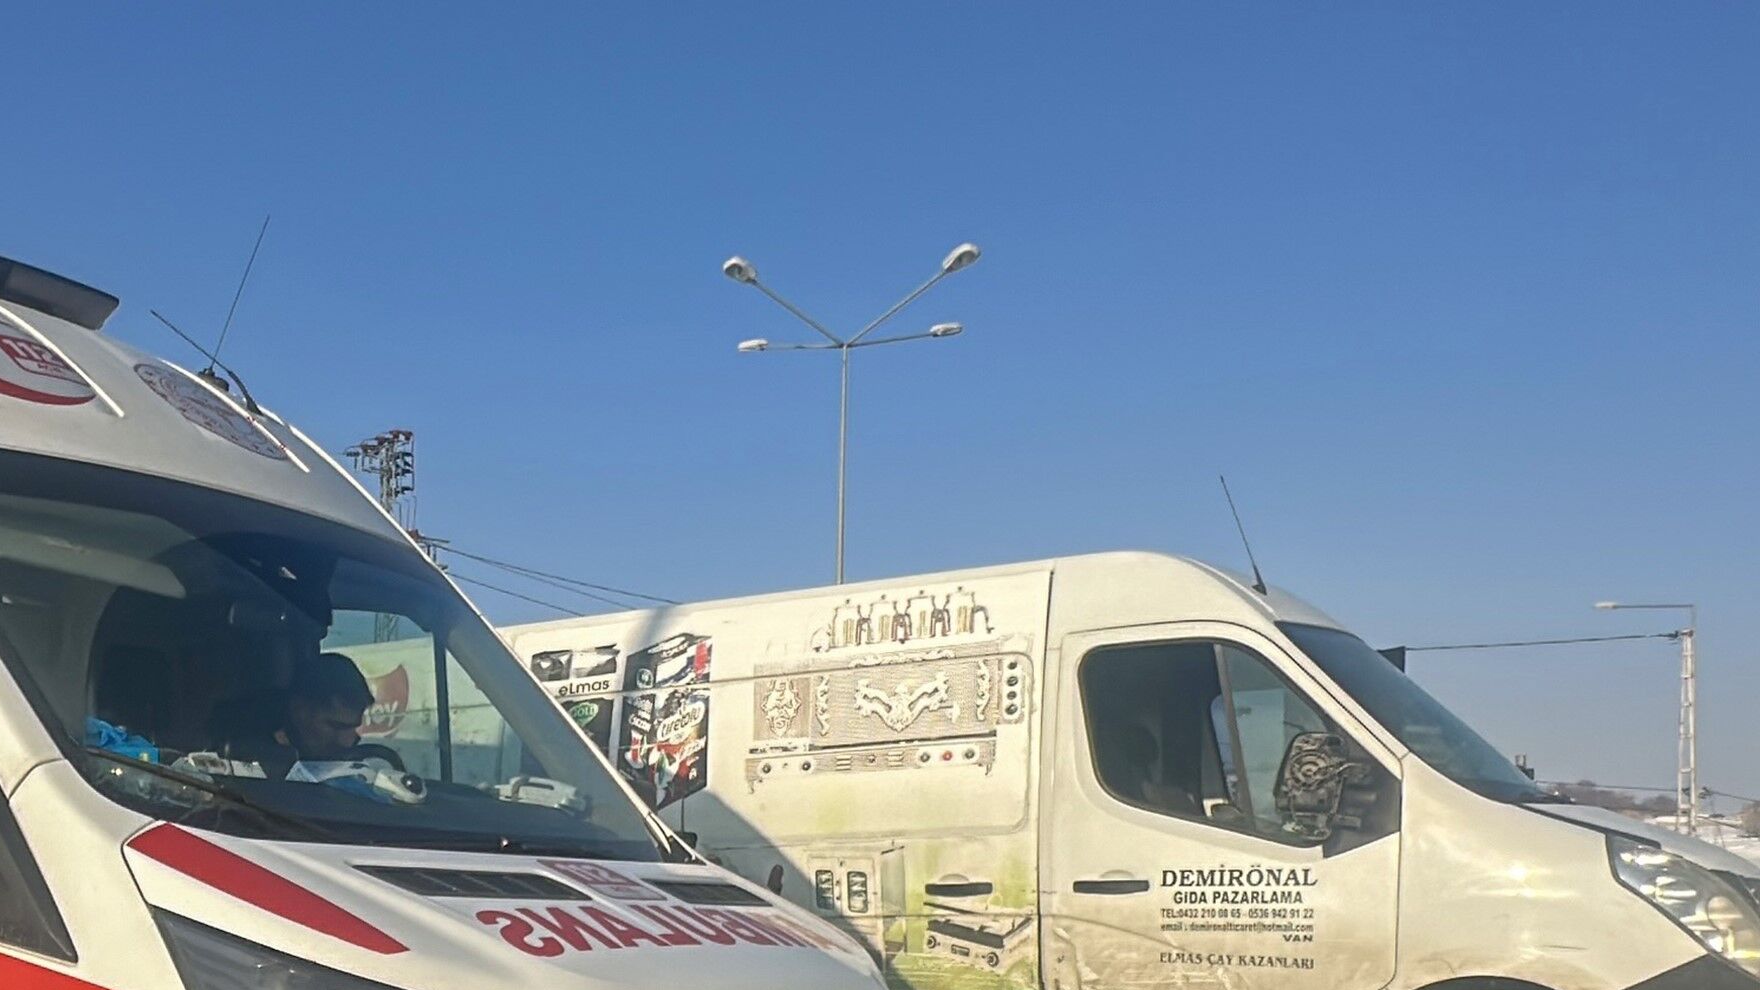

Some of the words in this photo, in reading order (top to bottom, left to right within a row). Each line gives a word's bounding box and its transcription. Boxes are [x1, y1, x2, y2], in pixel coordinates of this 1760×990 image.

[1161, 864, 1318, 887] DEMİRÖNAL
[1173, 891, 1208, 905] GIDA
[1212, 891, 1304, 905] PAZARLAMA
[1303, 908, 1314, 918] 22
[1159, 953, 1202, 965] ELMAS
[1208, 953, 1233, 968] ÇAY
[1239, 954, 1315, 969] KAZANLARI
